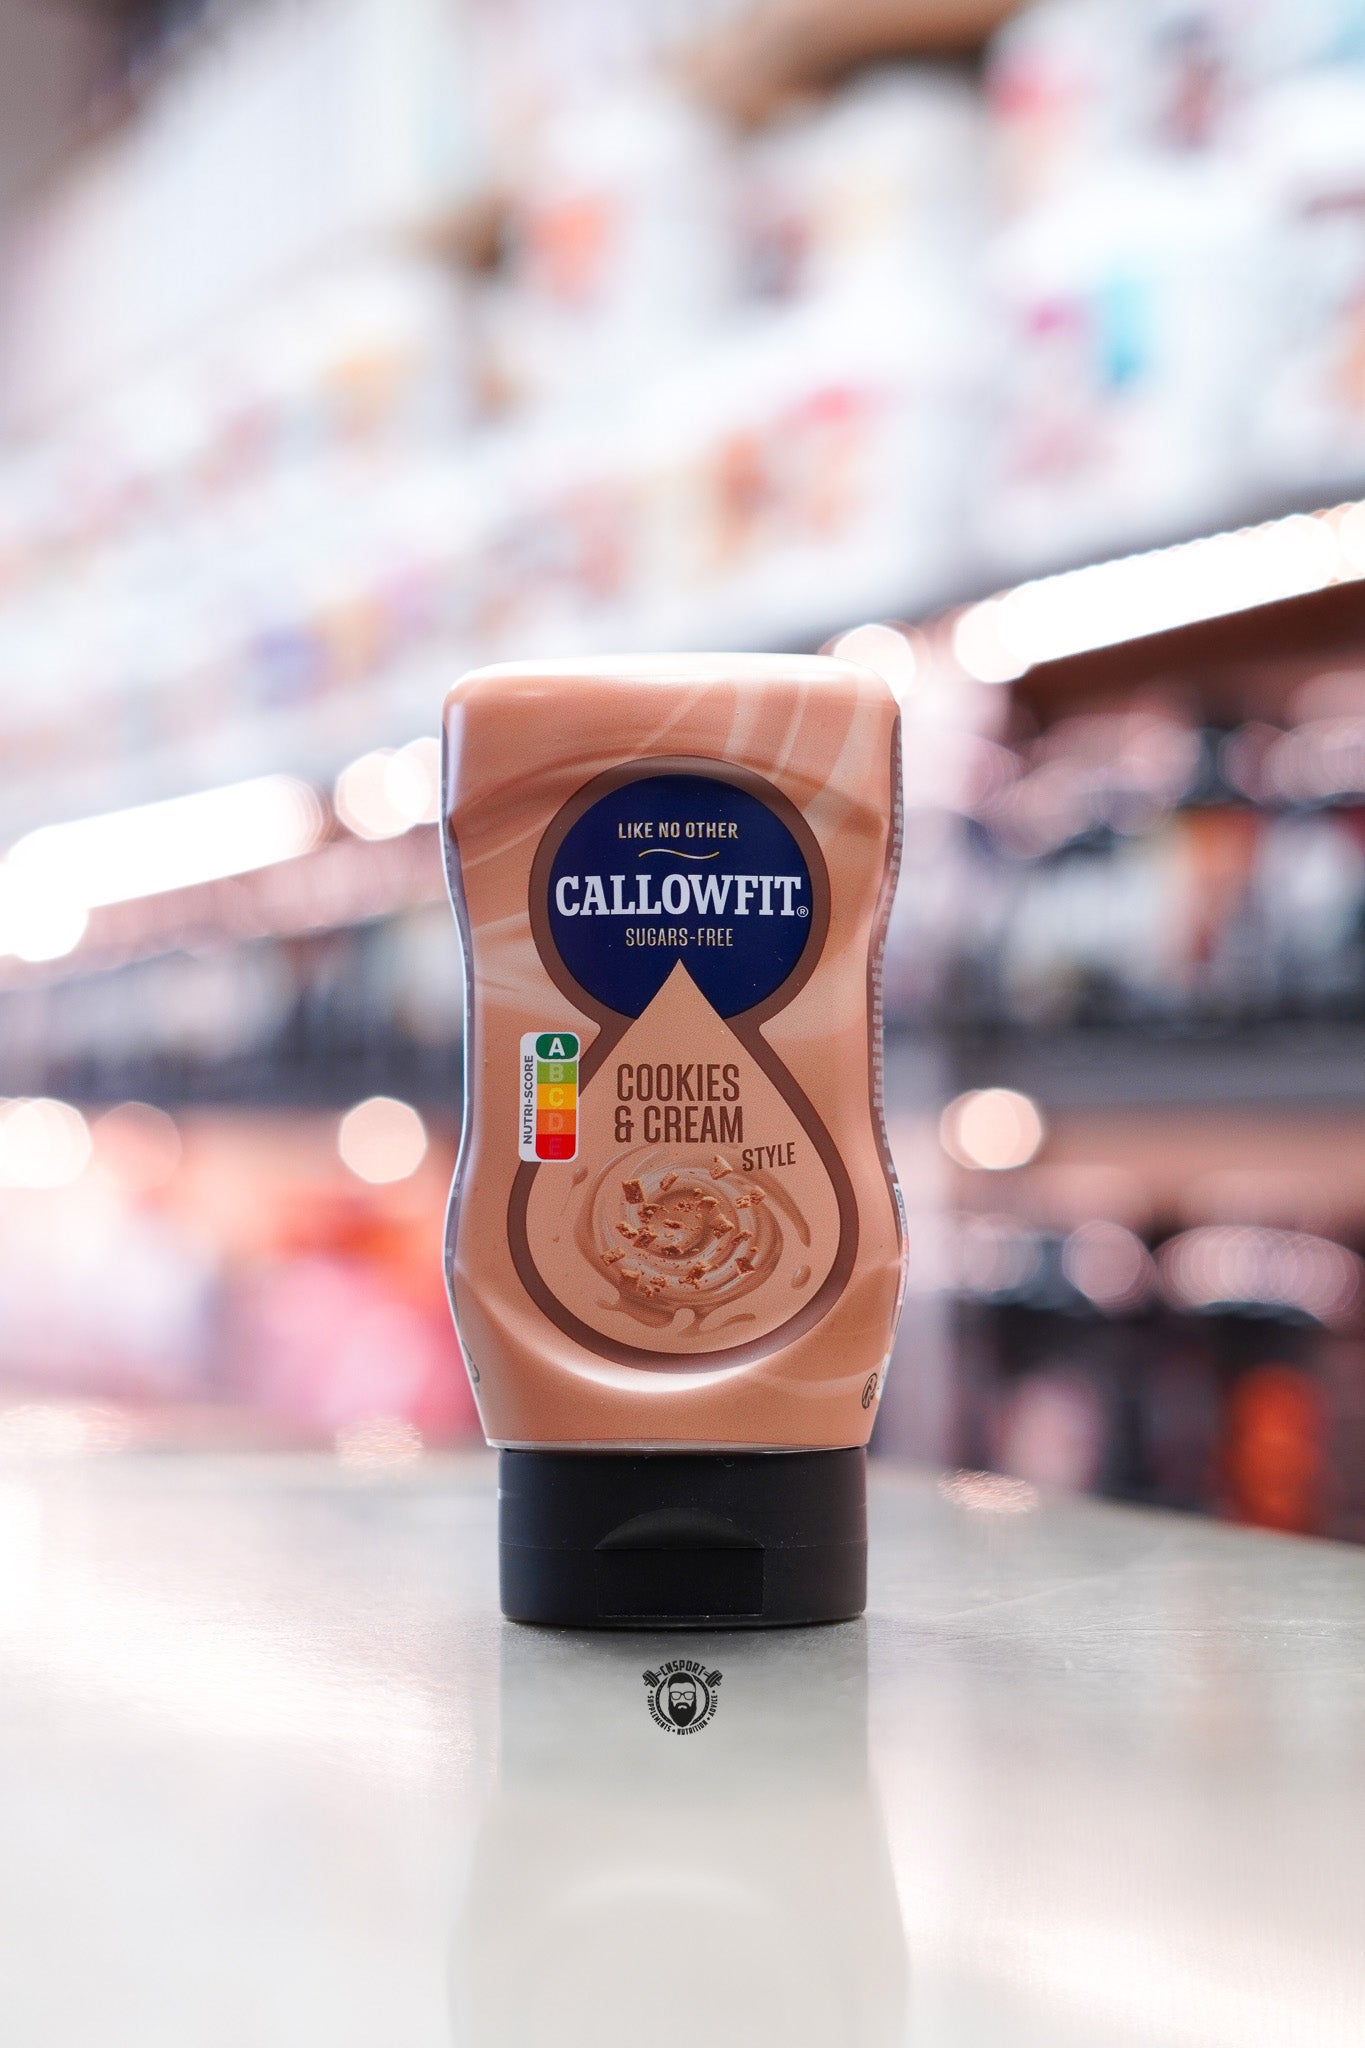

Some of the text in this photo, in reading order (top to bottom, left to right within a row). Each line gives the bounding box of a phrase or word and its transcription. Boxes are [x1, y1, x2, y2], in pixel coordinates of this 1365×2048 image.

[617, 821, 739, 840] LIKE NO OTHER
[625, 927, 734, 947] SUGARS-FREE
[548, 1037, 566, 1057] A
[550, 1063, 564, 1082] B
[616, 1063, 740, 1102] COOKIES
[522, 1055, 534, 1145] NUTRI-SCORE
[549, 1086, 564, 1107] C
[614, 1105, 744, 1144] & CREAM
[742, 1142, 796, 1171] STYLE
